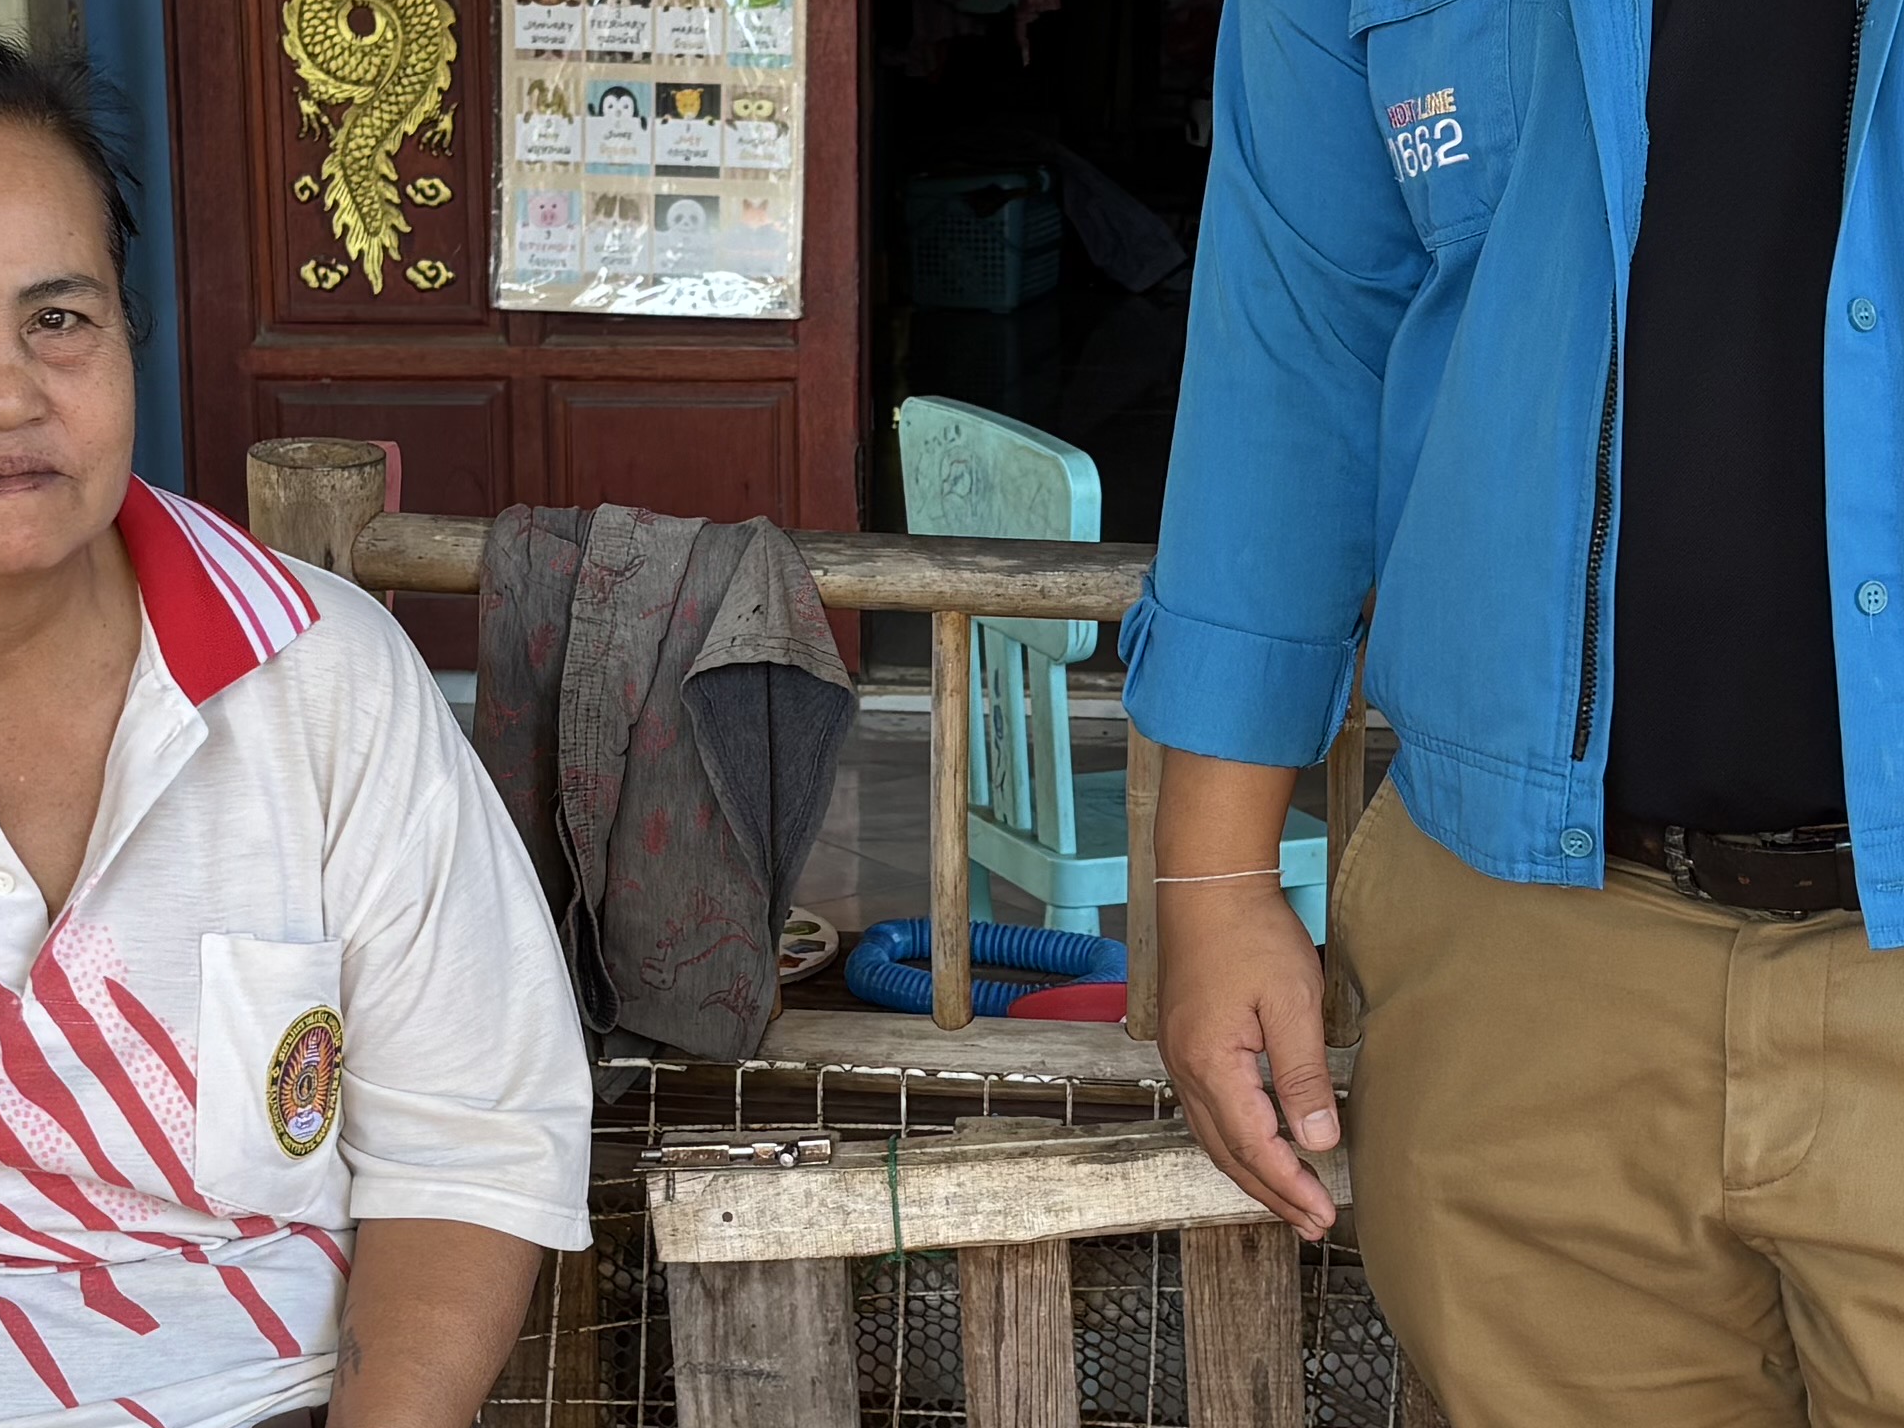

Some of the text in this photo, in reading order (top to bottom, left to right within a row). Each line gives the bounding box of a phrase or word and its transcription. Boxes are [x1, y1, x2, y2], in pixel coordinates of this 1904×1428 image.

[1387, 87, 1457, 129] HOT LINE
[1388, 118, 1470, 183] 1662
